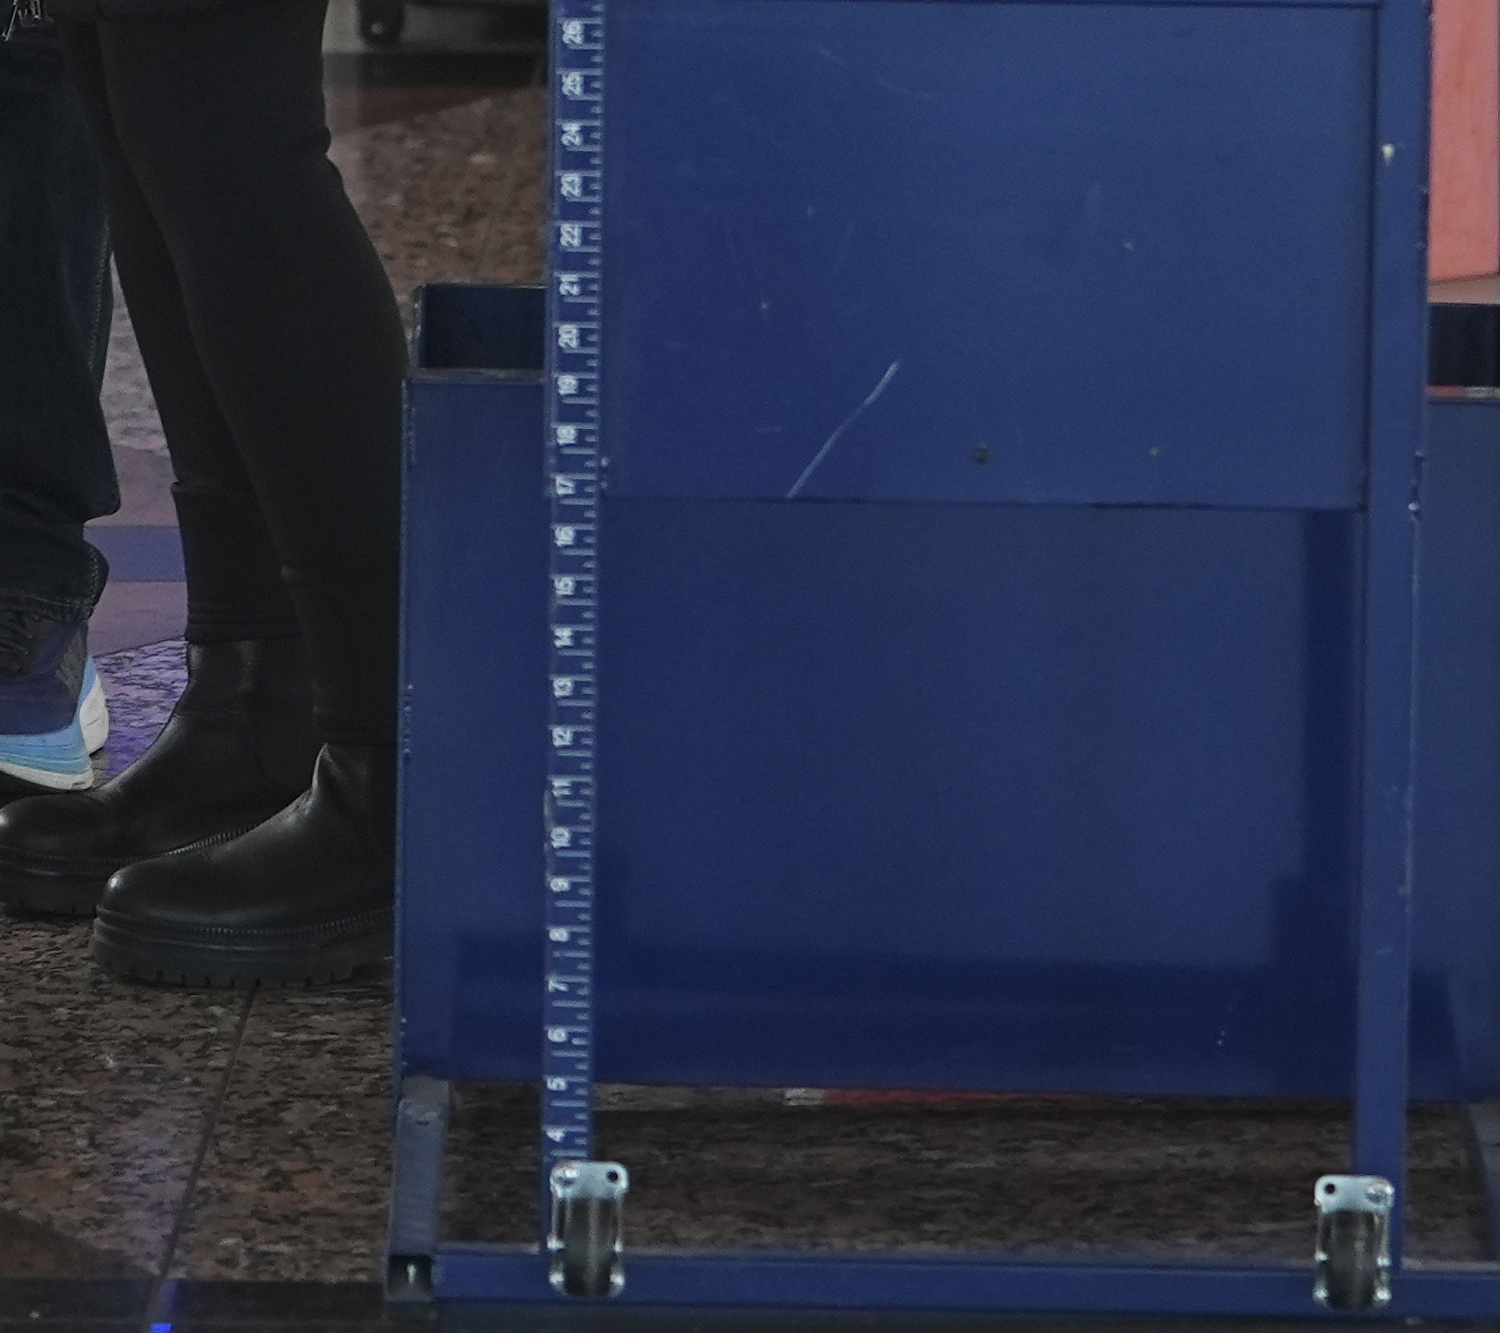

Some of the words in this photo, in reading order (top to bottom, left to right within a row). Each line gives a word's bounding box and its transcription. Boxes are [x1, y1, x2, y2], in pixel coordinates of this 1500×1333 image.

[562, 123, 581, 145] 24
[561, 174, 581, 196] 23
[560, 224, 580, 246] 22
[559, 275, 579, 295] 21
[558, 325, 579, 348] 20
[557, 375, 577, 394] 19
[556, 426, 576, 444] 18
[556, 477, 575, 494] 17
[555, 526, 576, 546] 16
[555, 577, 575, 595] 15
[554, 628, 573, 647] 14
[553, 678, 573, 697] 13
[552, 727, 572, 746] 12
[553, 779, 572, 796] 11
[550, 827, 571, 847] 10
[550, 877, 570, 891] 9
[549, 928, 569, 941] 8
[548, 977, 567, 991] 7
[548, 1029, 567, 1042] 6
[547, 1077, 567, 1090] 5
[546, 1129, 564, 1142] 4
